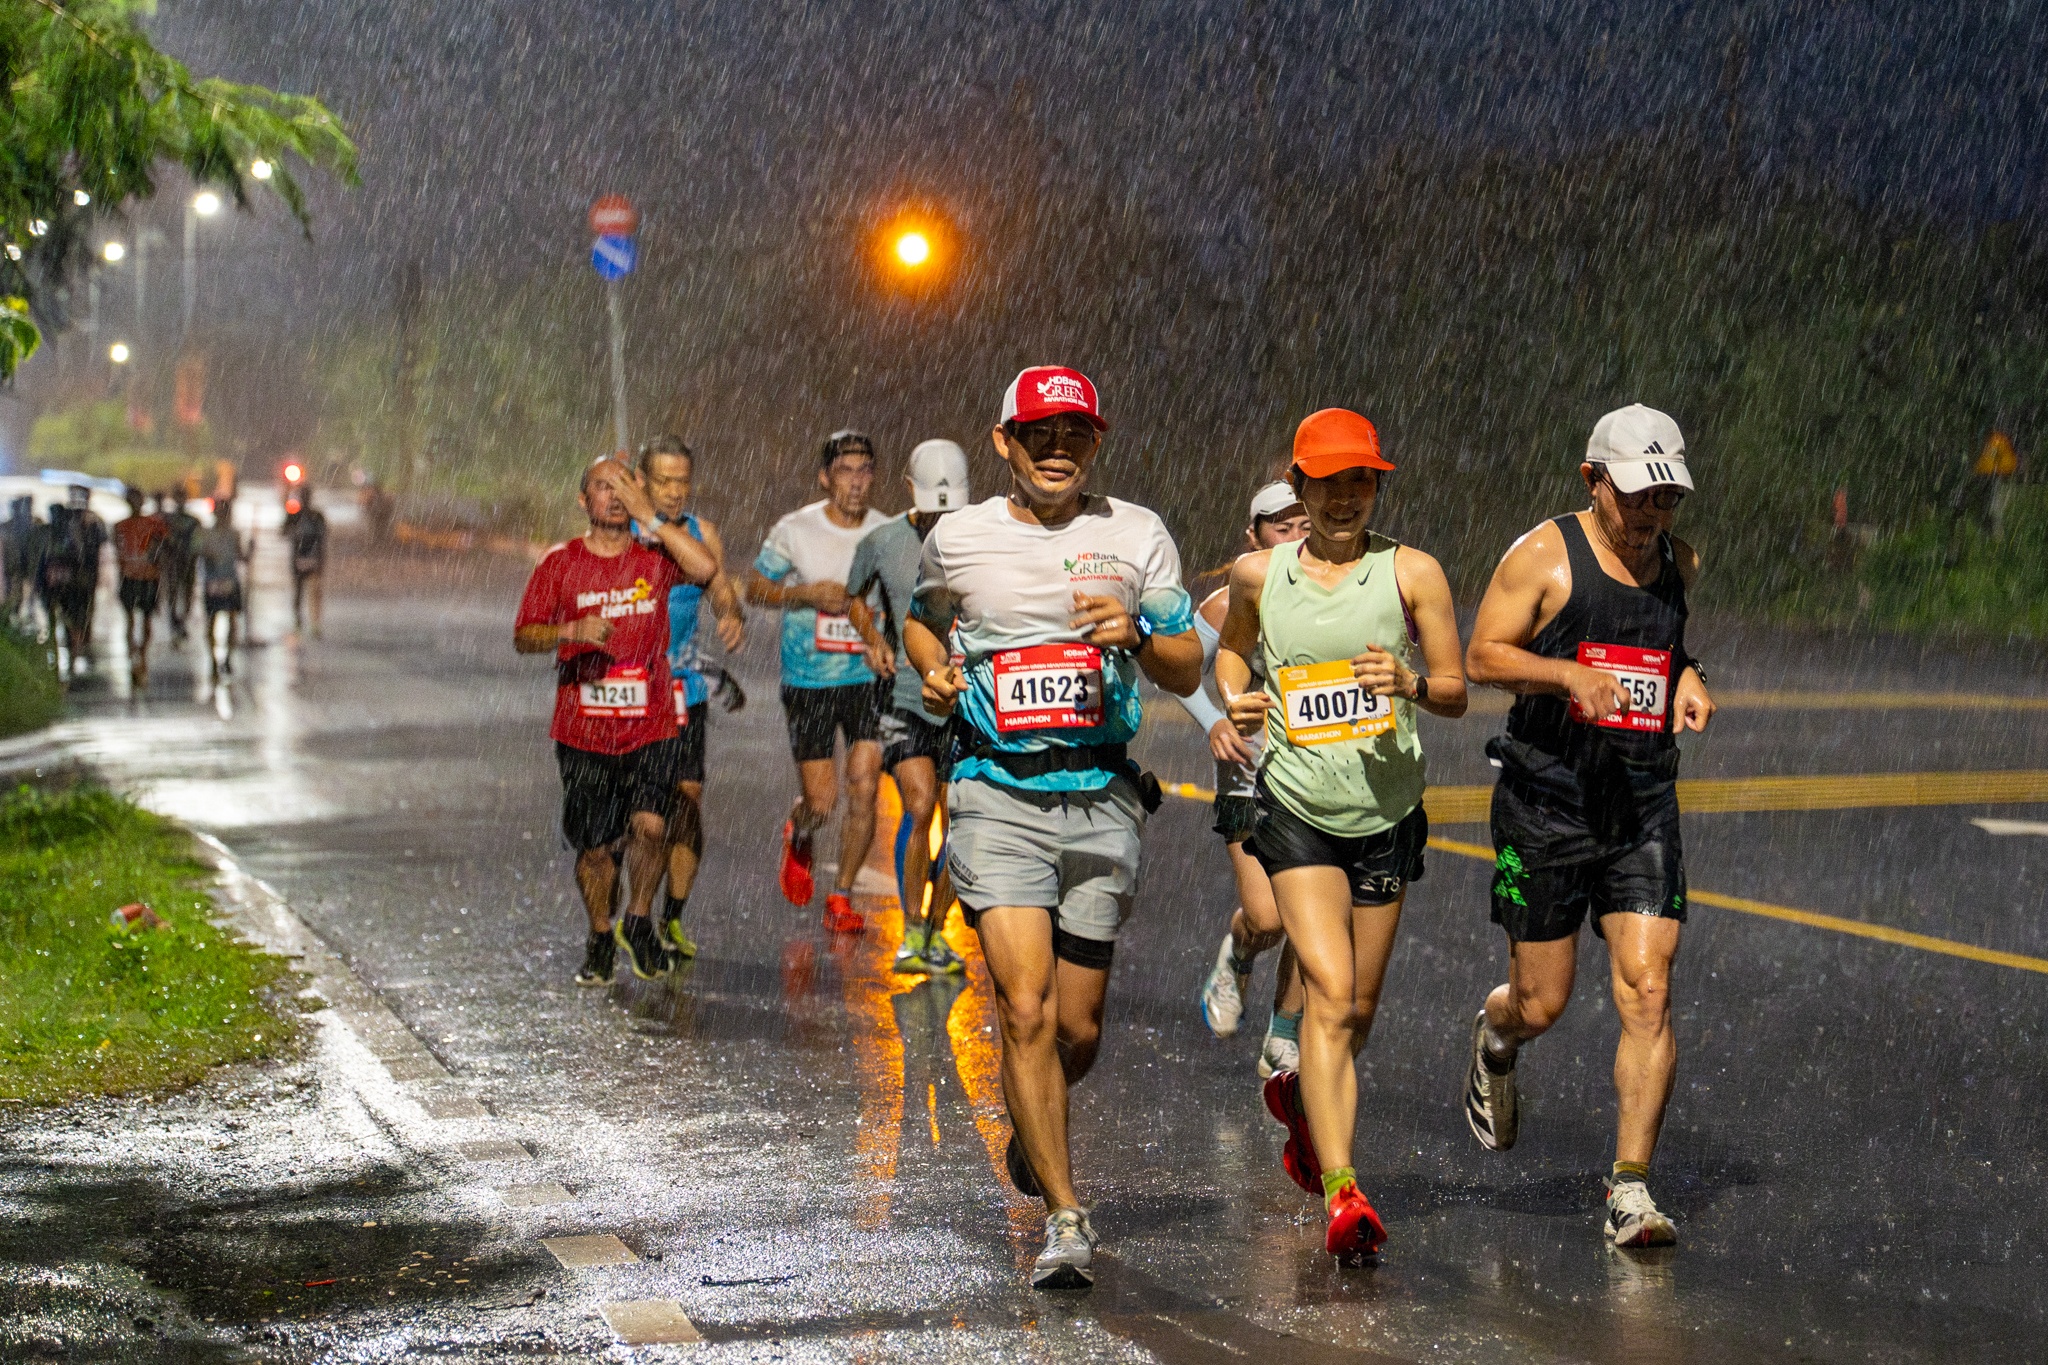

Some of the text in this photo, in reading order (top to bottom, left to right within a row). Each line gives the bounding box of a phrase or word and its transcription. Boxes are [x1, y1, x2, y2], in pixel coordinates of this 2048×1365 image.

[1049, 375, 1082, 389] HDBank
[1043, 385, 1084, 400] GREEN
[1078, 552, 1119, 561] HDBank
[590, 686, 636, 703] 41241
[1011, 675, 1088, 705] 41623
[1620, 677, 1657, 707] 553
[1299, 688, 1378, 721] 40079
[1005, 714, 1051, 727] MARATHON
[1296, 730, 1342, 742] MARATHON
